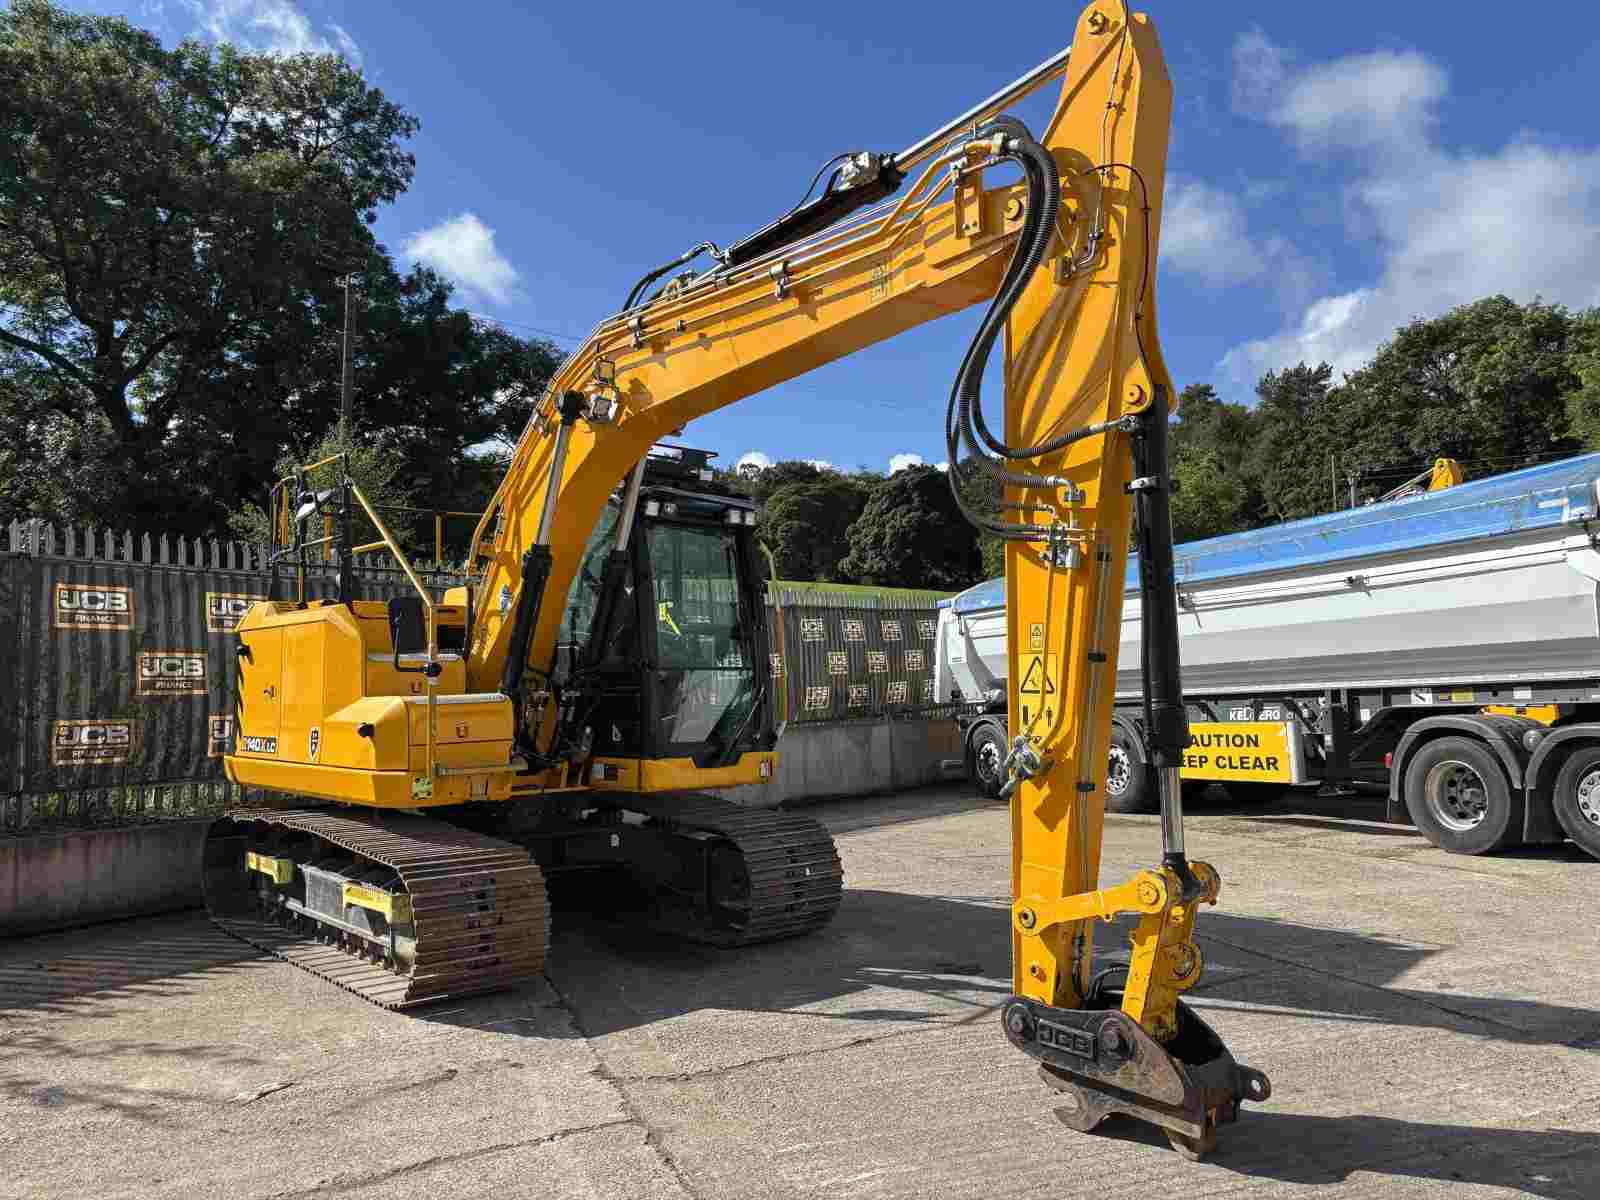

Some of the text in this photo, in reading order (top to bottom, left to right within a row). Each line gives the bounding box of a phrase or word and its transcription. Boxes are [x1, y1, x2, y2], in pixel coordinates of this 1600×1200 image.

[60, 591, 128, 610] JCB
[210, 599, 248, 616] JC
[143, 658, 204, 677] JCB
[1229, 707, 1281, 721] KELERG
[58, 726, 129, 744] JCB
[1191, 734, 1260, 748] AUTION
[1184, 755, 1280, 770] EP CLEAR
